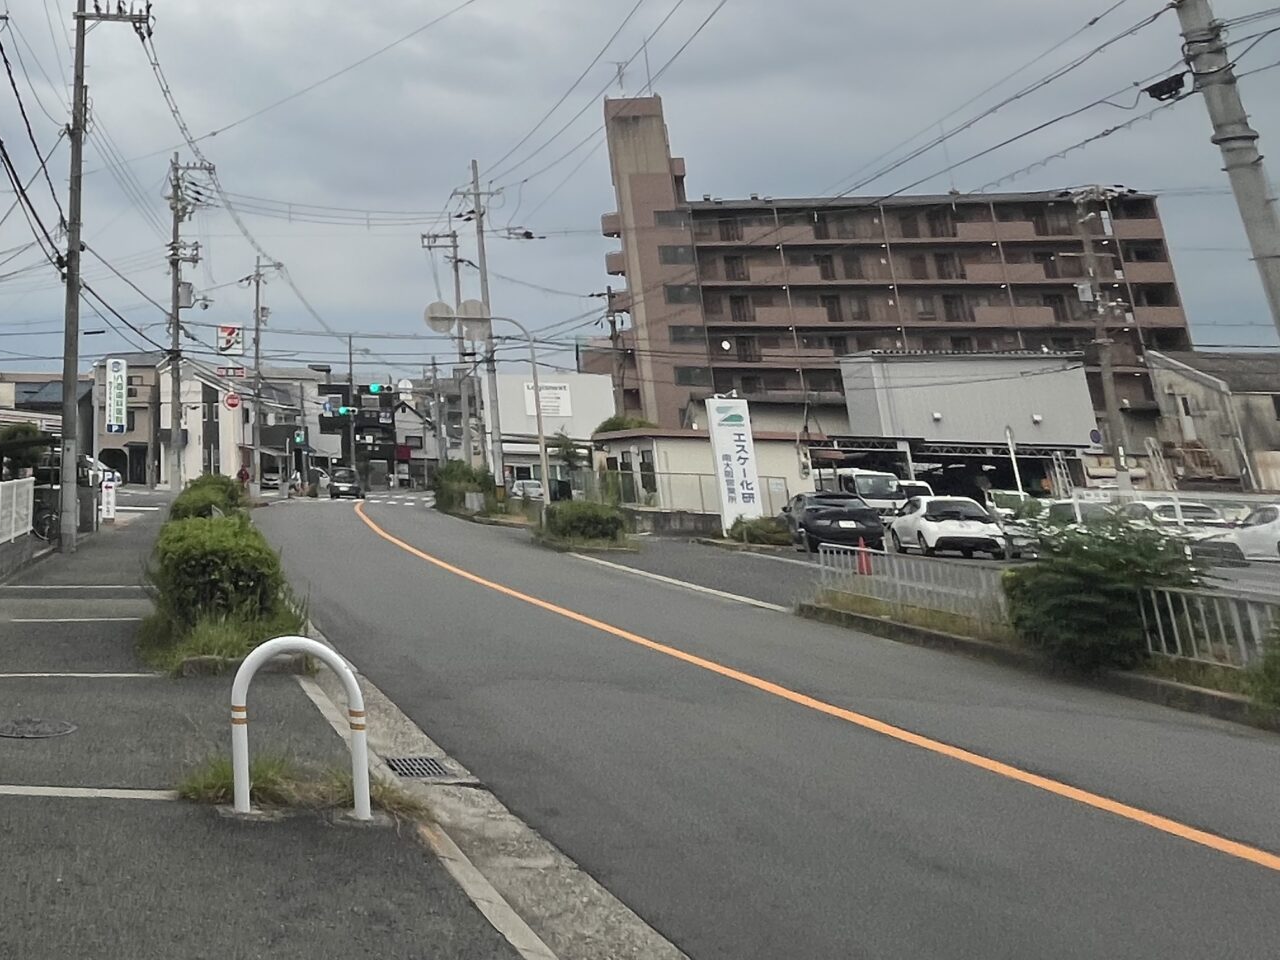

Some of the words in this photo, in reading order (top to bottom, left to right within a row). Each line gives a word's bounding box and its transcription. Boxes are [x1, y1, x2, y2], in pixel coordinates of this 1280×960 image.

[104, 472, 113, 482] P
[732, 432, 756, 504] エスケー化研
